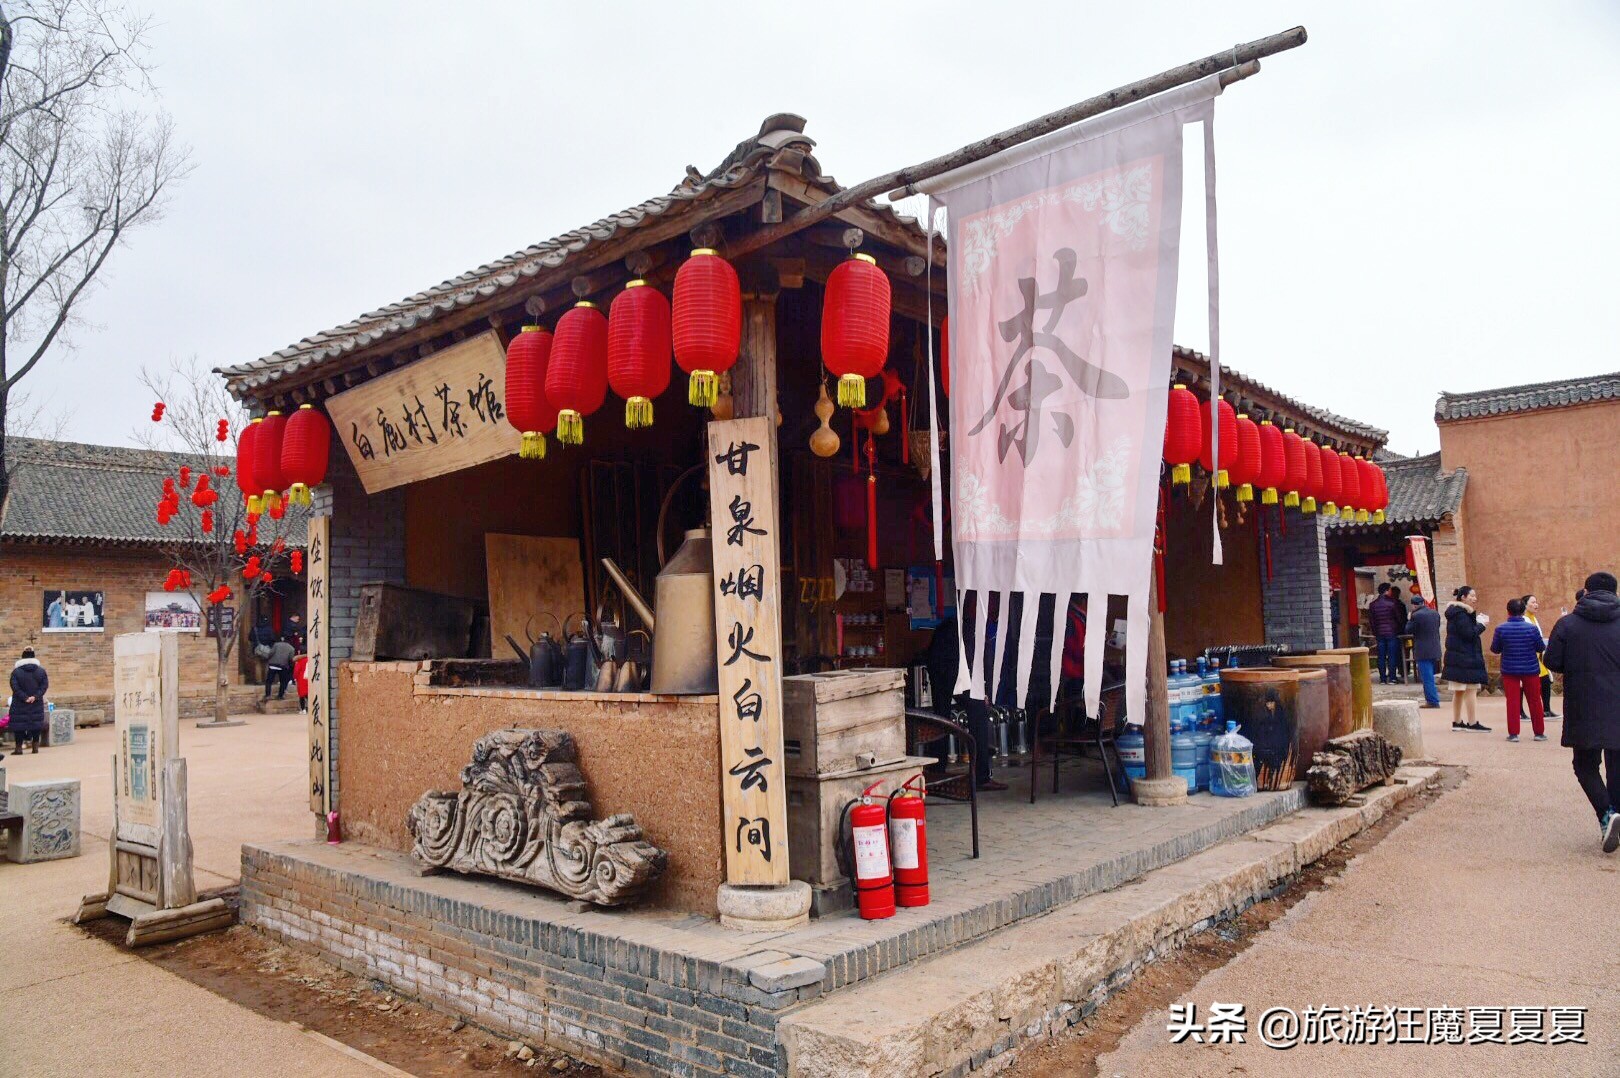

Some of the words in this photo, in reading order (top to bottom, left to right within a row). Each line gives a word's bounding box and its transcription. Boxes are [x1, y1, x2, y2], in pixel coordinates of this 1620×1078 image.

[352, 373, 505, 461] 白鹿村茶馆
[967, 247, 1130, 470] 茶
[309, 532, 324, 797] 坐饮香茗爱此山
[715, 440, 772, 863] 甘泉烟火白云间
